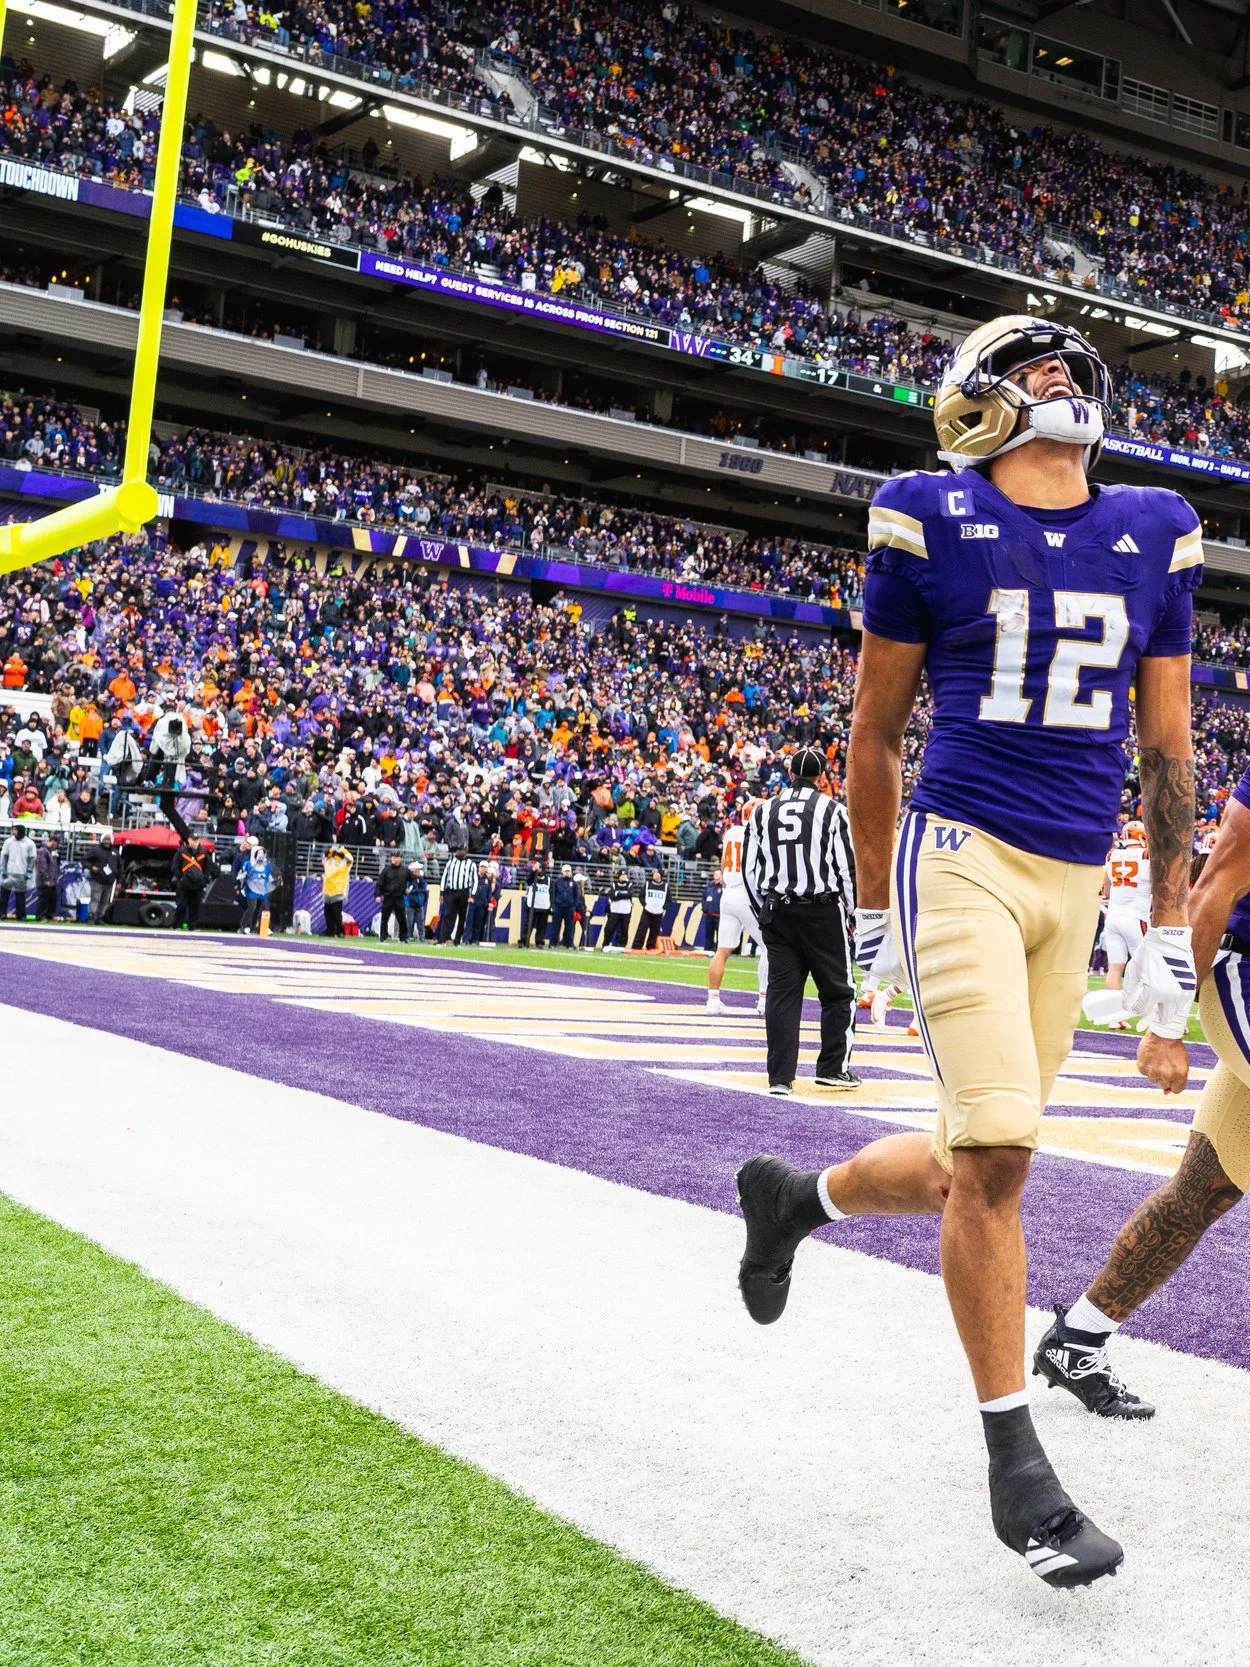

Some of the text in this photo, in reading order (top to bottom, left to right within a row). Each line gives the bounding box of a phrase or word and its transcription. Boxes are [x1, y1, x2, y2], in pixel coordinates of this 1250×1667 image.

[0, 160, 79, 201] TOUCHDOWN
[261, 231, 332, 258] #GOHUSKIES
[375, 261, 659, 340] NEED HELP? GUEST SERVICES IS ACROSS FROM SECTION 121
[672, 331, 710, 357] W
[729, 347, 754, 366] 34
[816, 368, 838, 386] 17
[1101, 437, 1164, 461] ASKETBALL
[947, 490, 966, 515] C
[421, 541, 444, 561] W
[1043, 531, 1067, 548] W
[675, 584, 715, 605] Mobile
[978, 588, 1130, 730] 12
[777, 801, 806, 841] S
[933, 826, 972, 852] W
[724, 841, 741, 872] 41
[1111, 861, 1139, 888] 52
